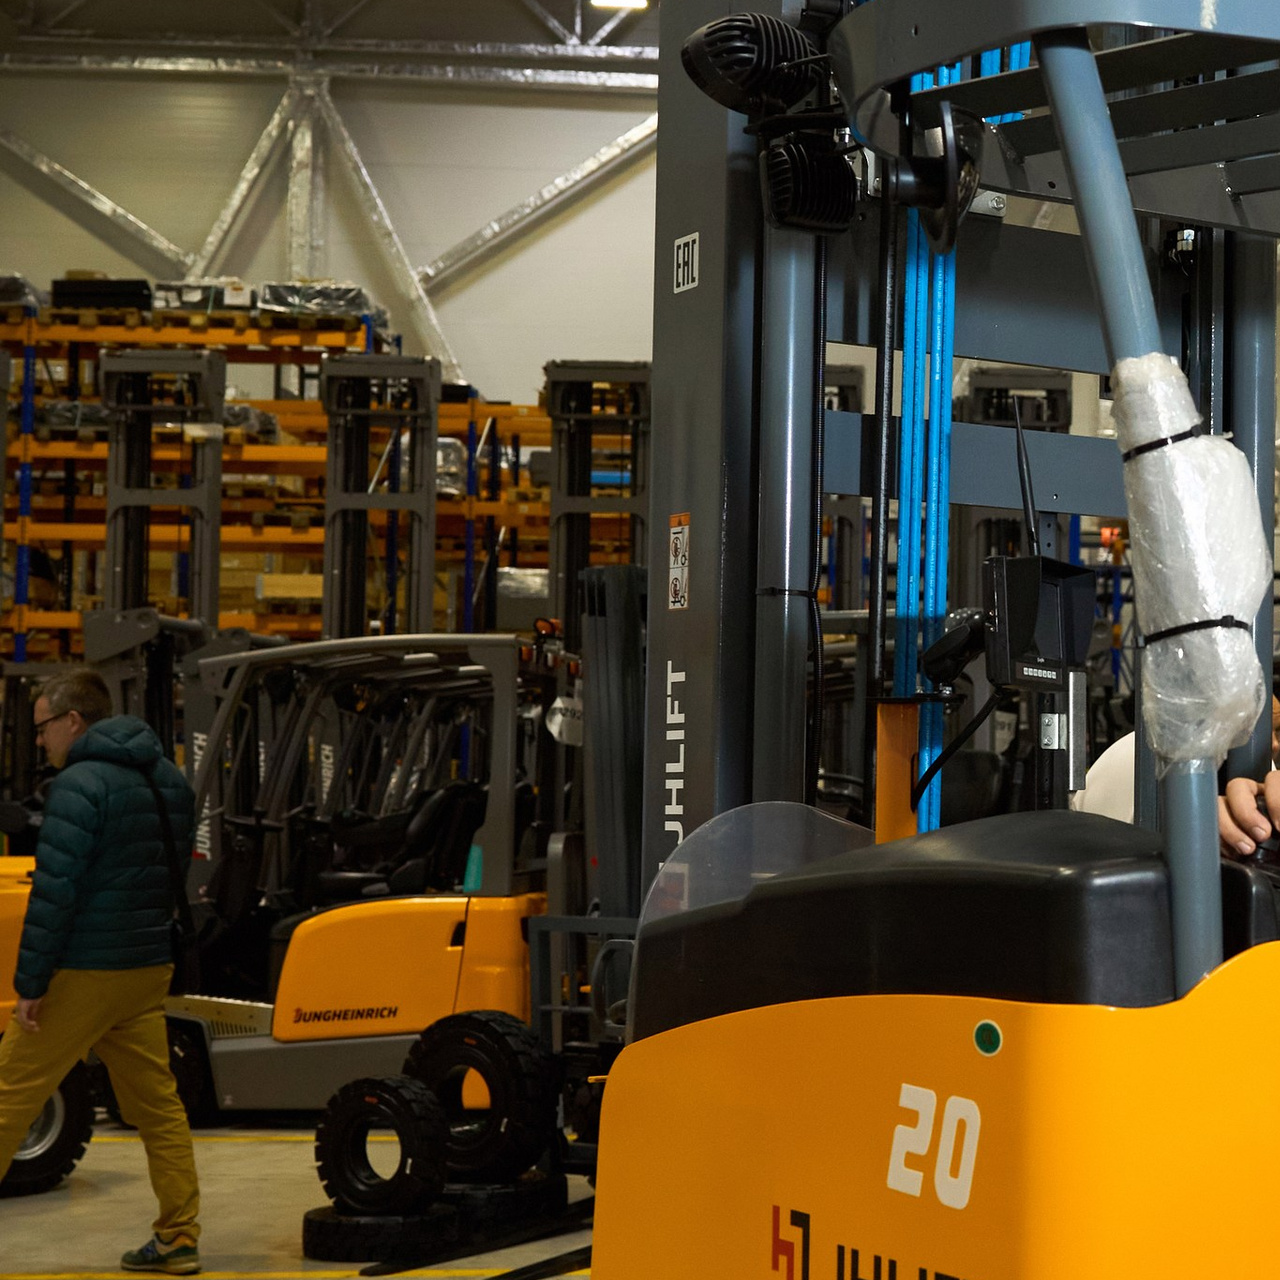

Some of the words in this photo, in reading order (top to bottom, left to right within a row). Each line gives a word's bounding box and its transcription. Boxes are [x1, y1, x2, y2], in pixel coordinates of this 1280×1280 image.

[664, 660, 686, 846] JHLIFT
[293, 1006, 399, 1024] JUNGHEINRICH
[886, 1083, 982, 1210] 20
